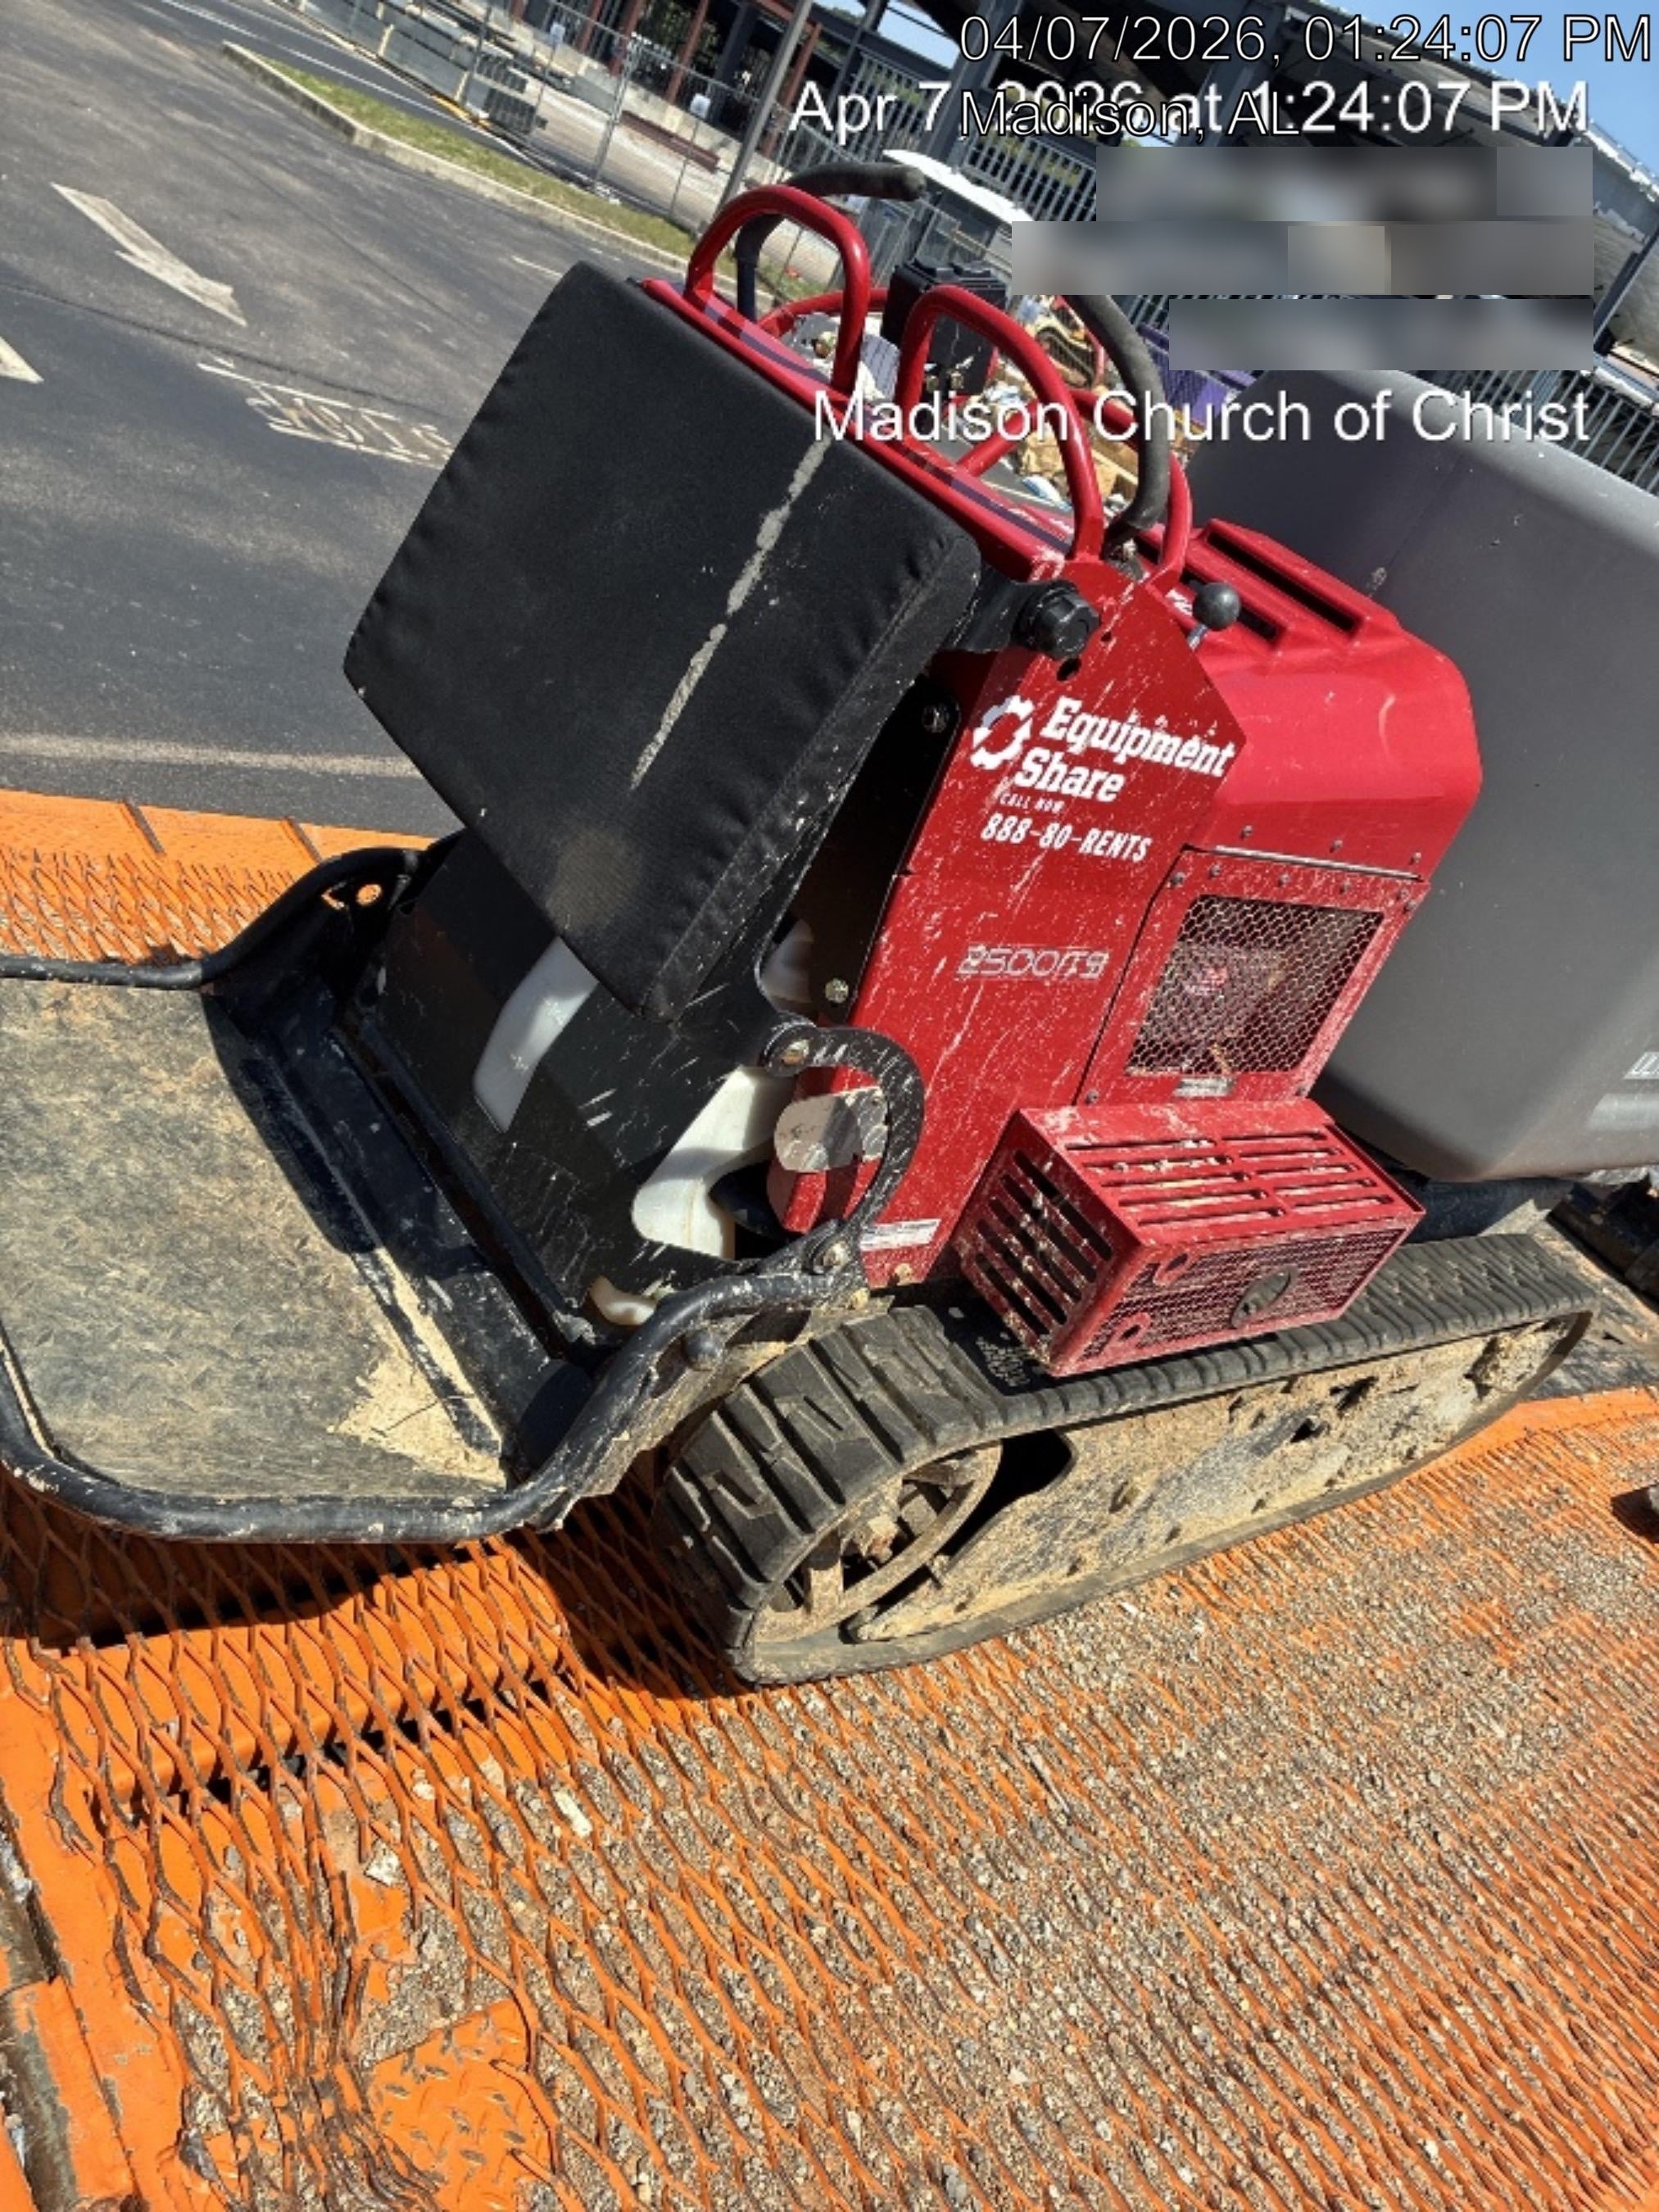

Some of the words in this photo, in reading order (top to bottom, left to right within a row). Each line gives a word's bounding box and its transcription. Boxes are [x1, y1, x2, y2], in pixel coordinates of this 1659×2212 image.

[1040, 696, 1235, 777] Equipment
[999, 791, 1031, 810] CALL
[1014, 746, 1126, 803] Share
[980, 812, 1153, 863] 888-80-RENTS
